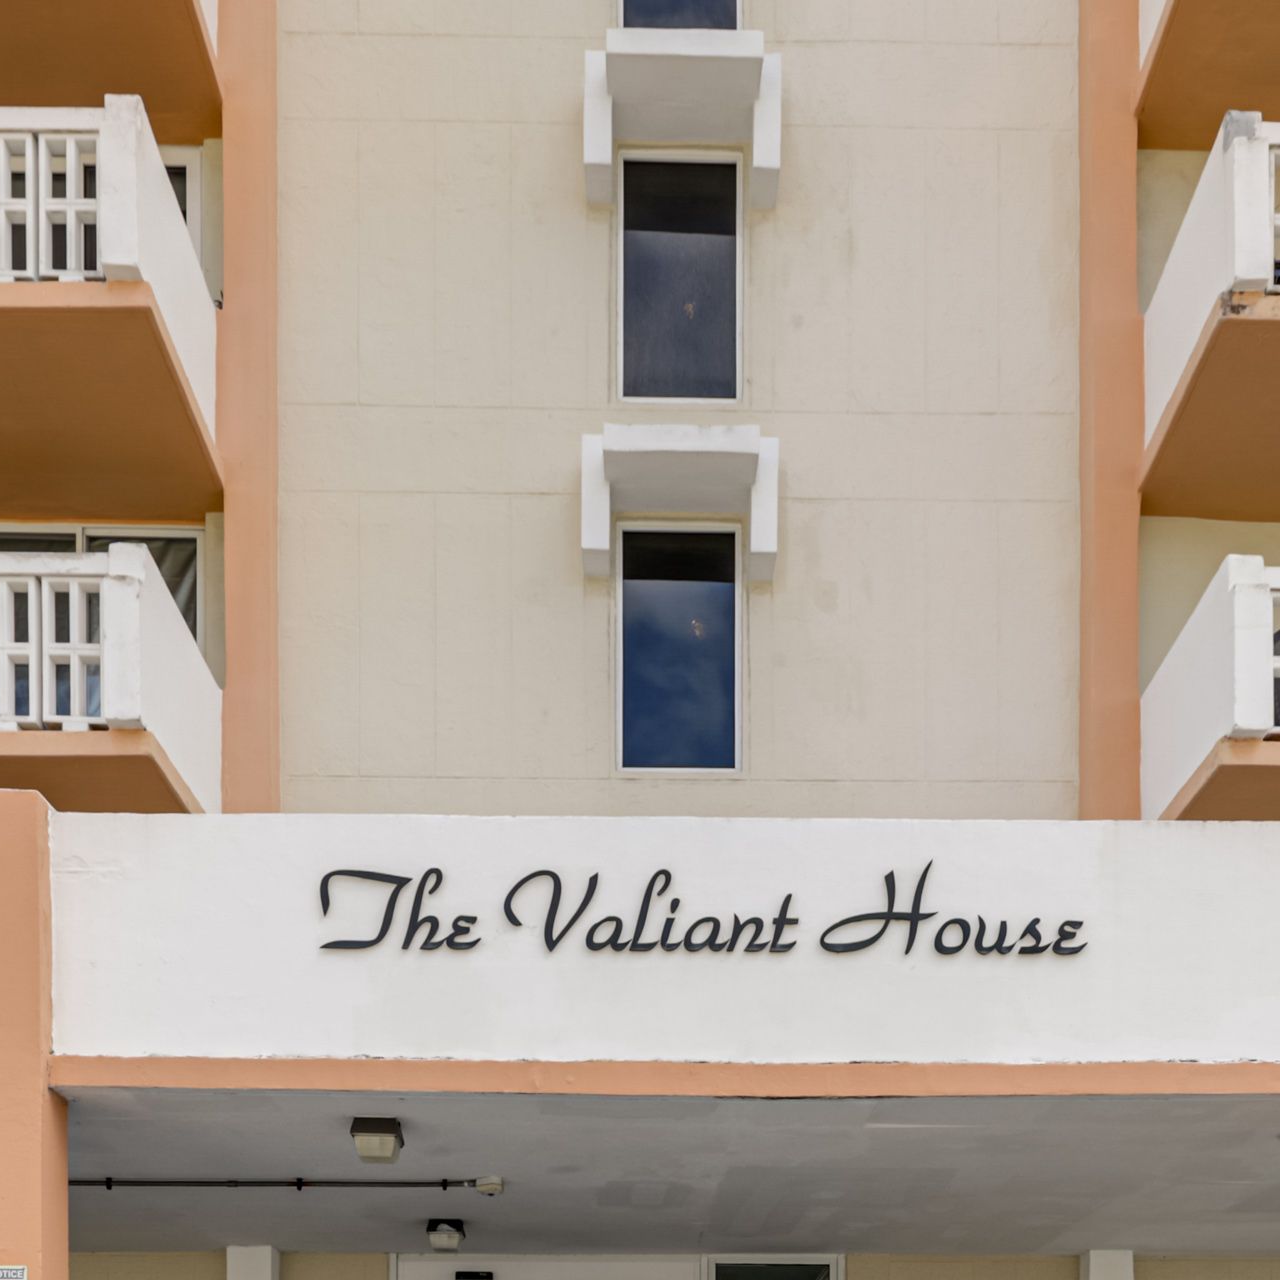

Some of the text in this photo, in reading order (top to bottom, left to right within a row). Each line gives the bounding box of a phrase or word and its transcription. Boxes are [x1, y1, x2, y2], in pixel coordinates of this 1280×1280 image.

[320, 861, 1087, 955] The Valiant House
